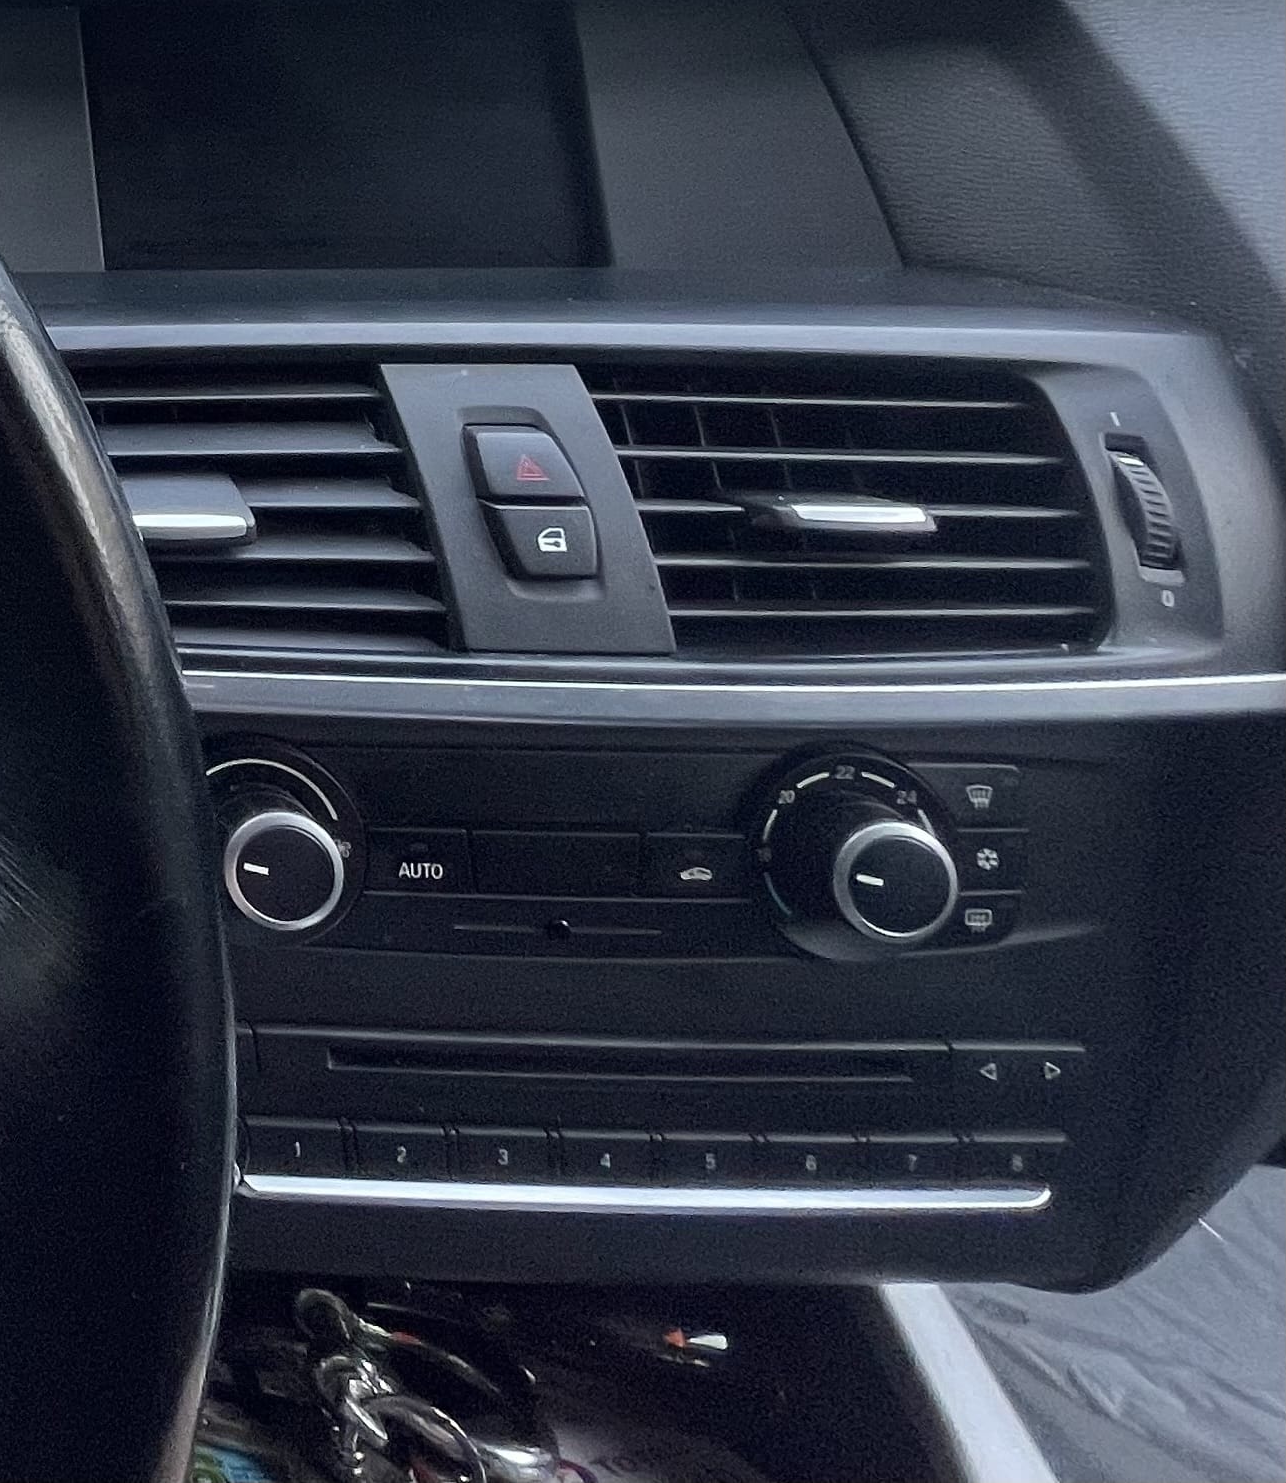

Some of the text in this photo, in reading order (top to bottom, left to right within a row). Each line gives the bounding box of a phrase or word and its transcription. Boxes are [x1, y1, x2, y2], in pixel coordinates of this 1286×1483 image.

[398, 862, 443, 880] AUTO
[294, 1141, 301, 1158] 1
[396, 1145, 407, 1163] 2
[497, 1149, 509, 1166] 3
[600, 1152, 611, 1169] 4
[705, 1152, 717, 1170] 5
[805, 1154, 818, 1172] 6
[908, 1153, 919, 1171] 7
